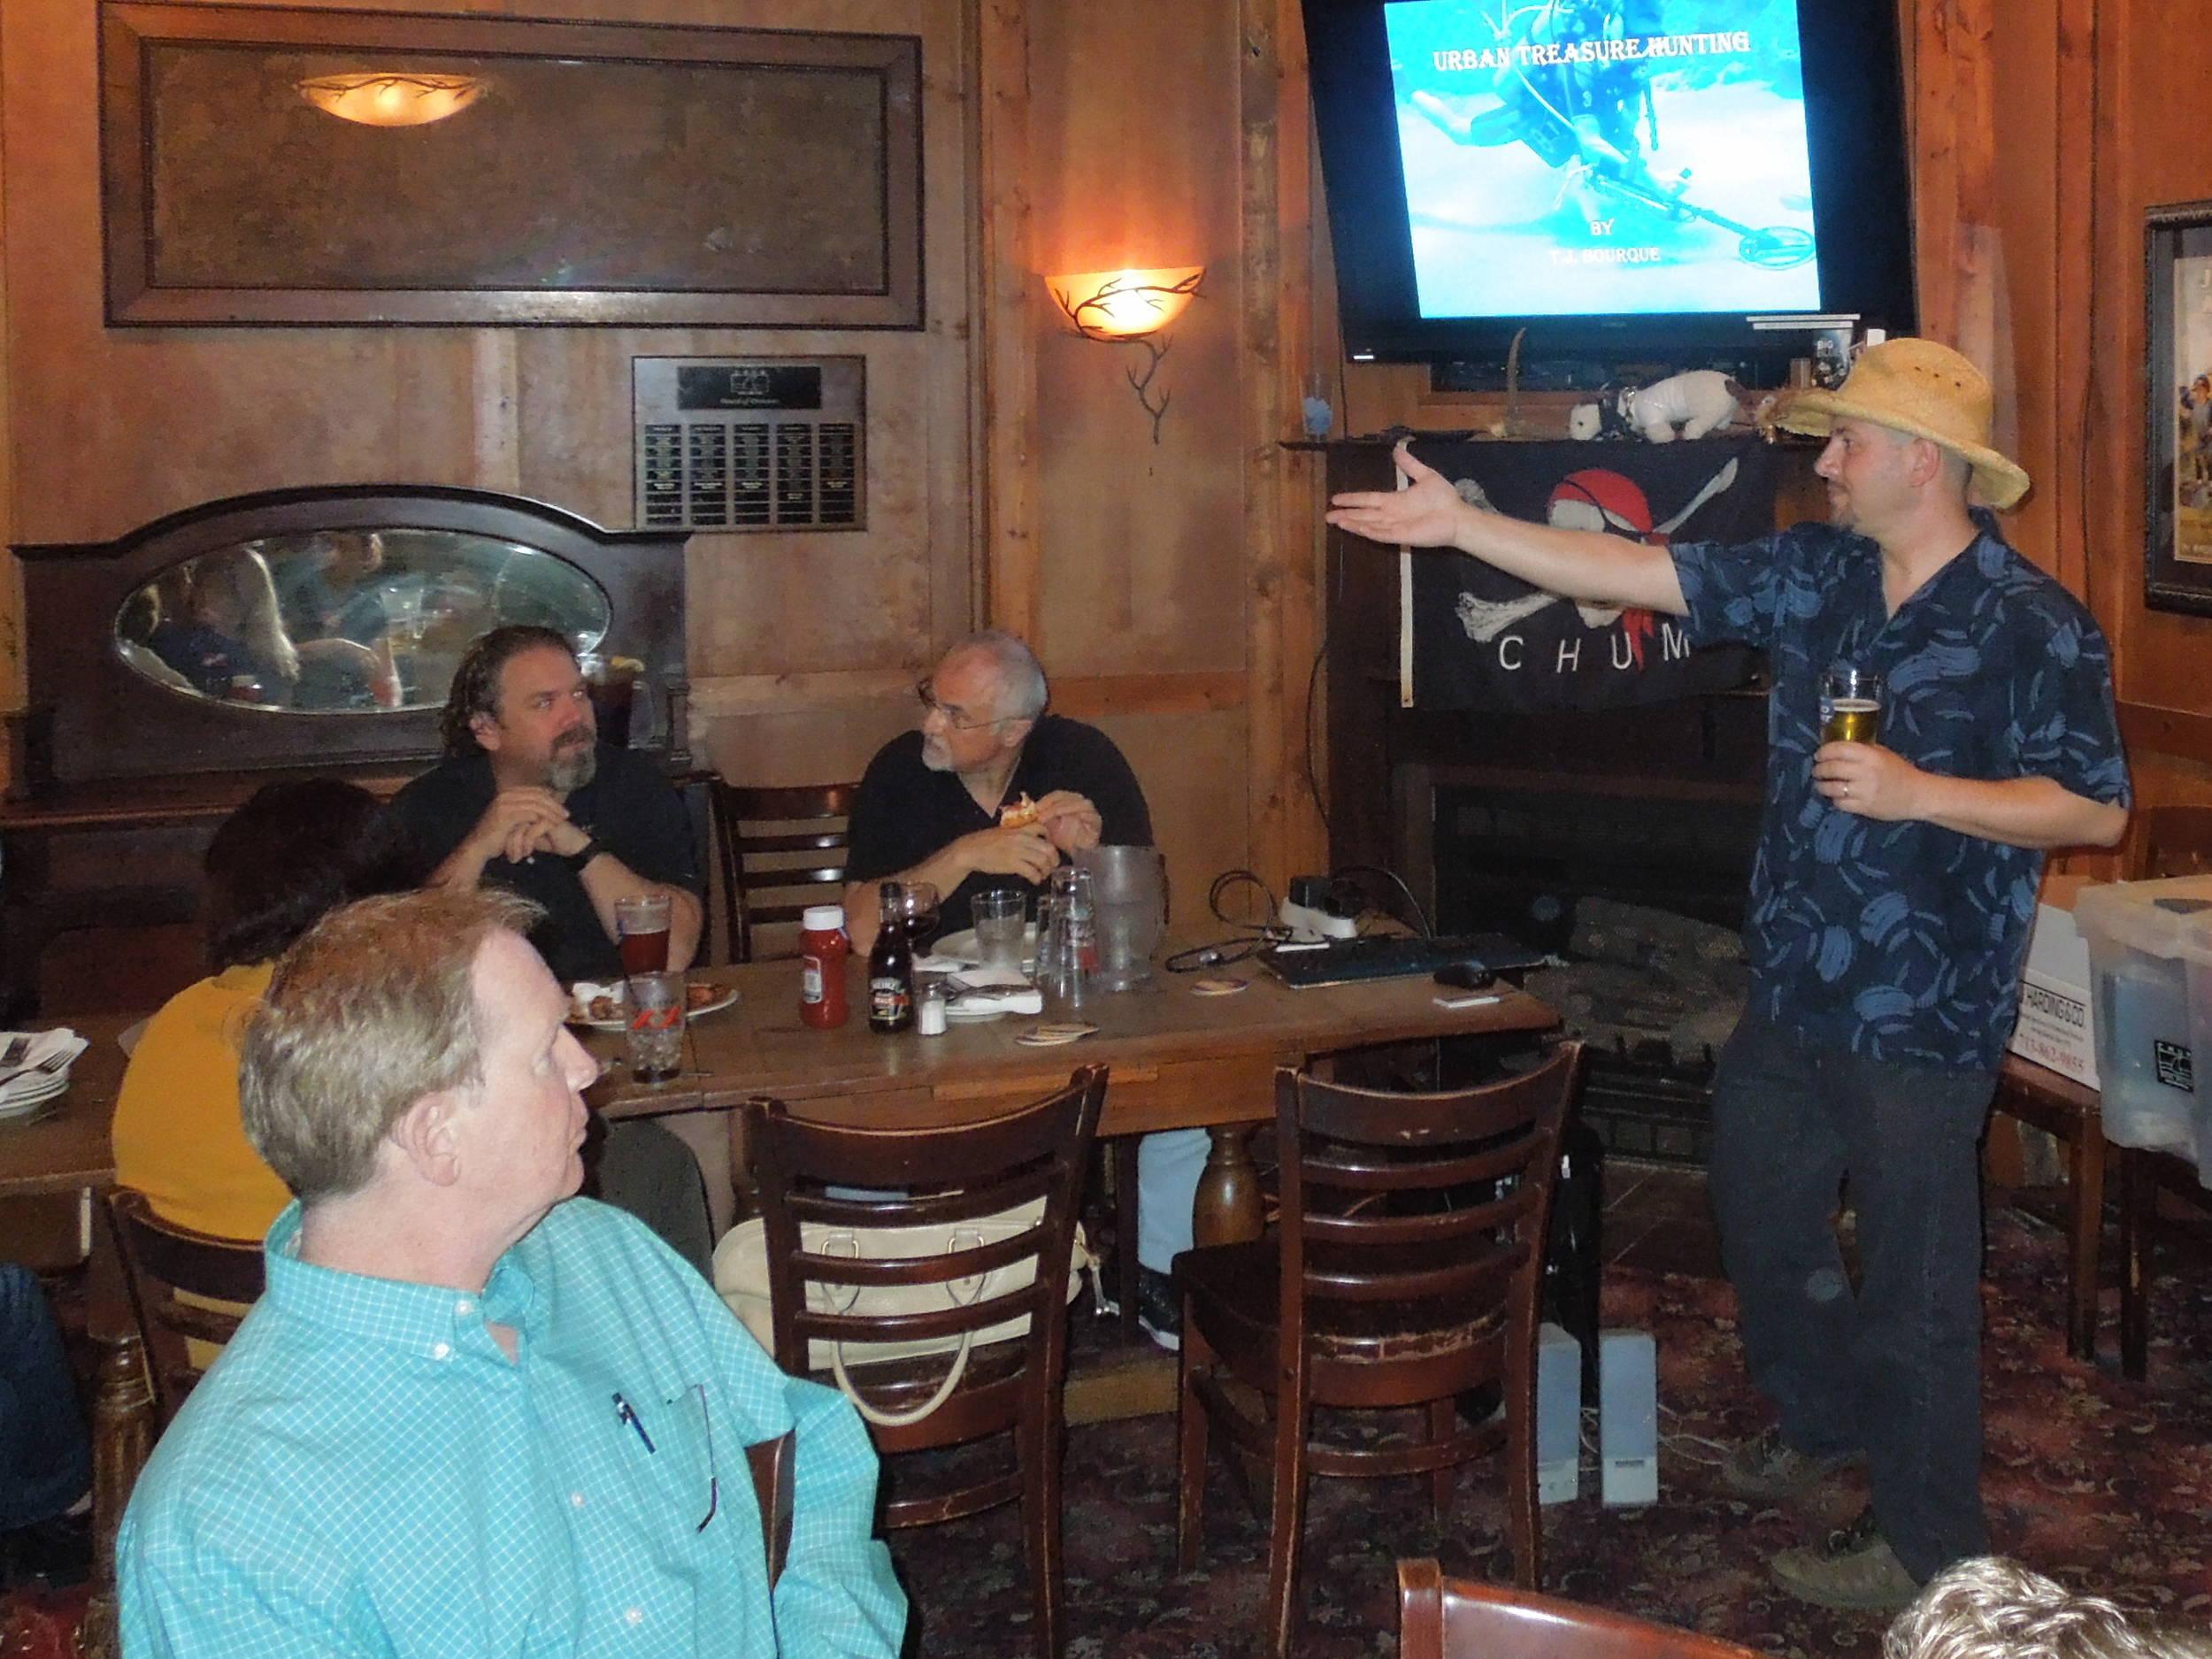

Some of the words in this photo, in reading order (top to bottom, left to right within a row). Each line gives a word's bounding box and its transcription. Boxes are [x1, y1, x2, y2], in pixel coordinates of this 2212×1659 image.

[1434, 50, 1509, 72] URBAN
[1518, 38, 1640, 66] TREASURE
[1646, 33, 1750, 58] HUNTING
[1591, 218, 1614, 235] BY
[1583, 248, 1661, 264] BOURQUE
[1499, 623, 1691, 673] CHUM
